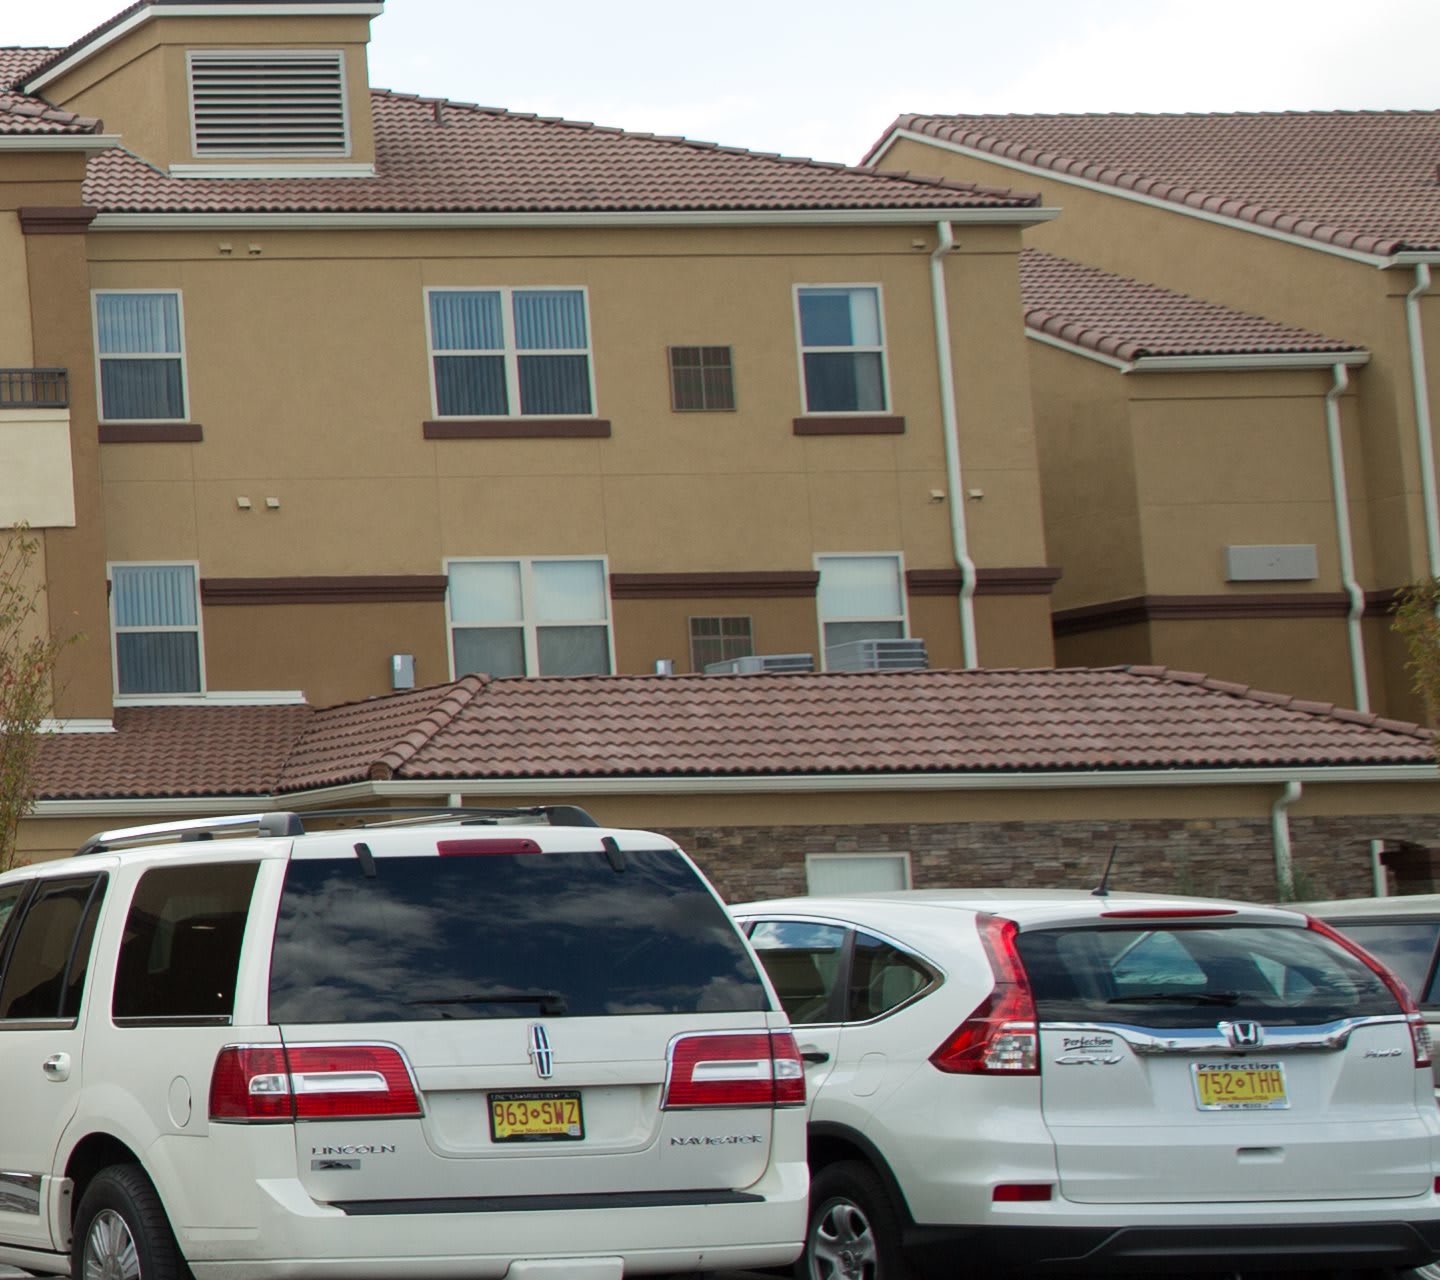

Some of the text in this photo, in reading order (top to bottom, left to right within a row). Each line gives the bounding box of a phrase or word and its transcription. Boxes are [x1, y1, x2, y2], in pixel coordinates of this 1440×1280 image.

[1197, 1063, 1280, 1071] Perfection
[1198, 1072, 1284, 1095] 752 THH
[493, 1101, 577, 1126] 963 SWZ
[669, 1134, 764, 1147] NAVIGATOR
[311, 1143, 397, 1156] LINCOLN
